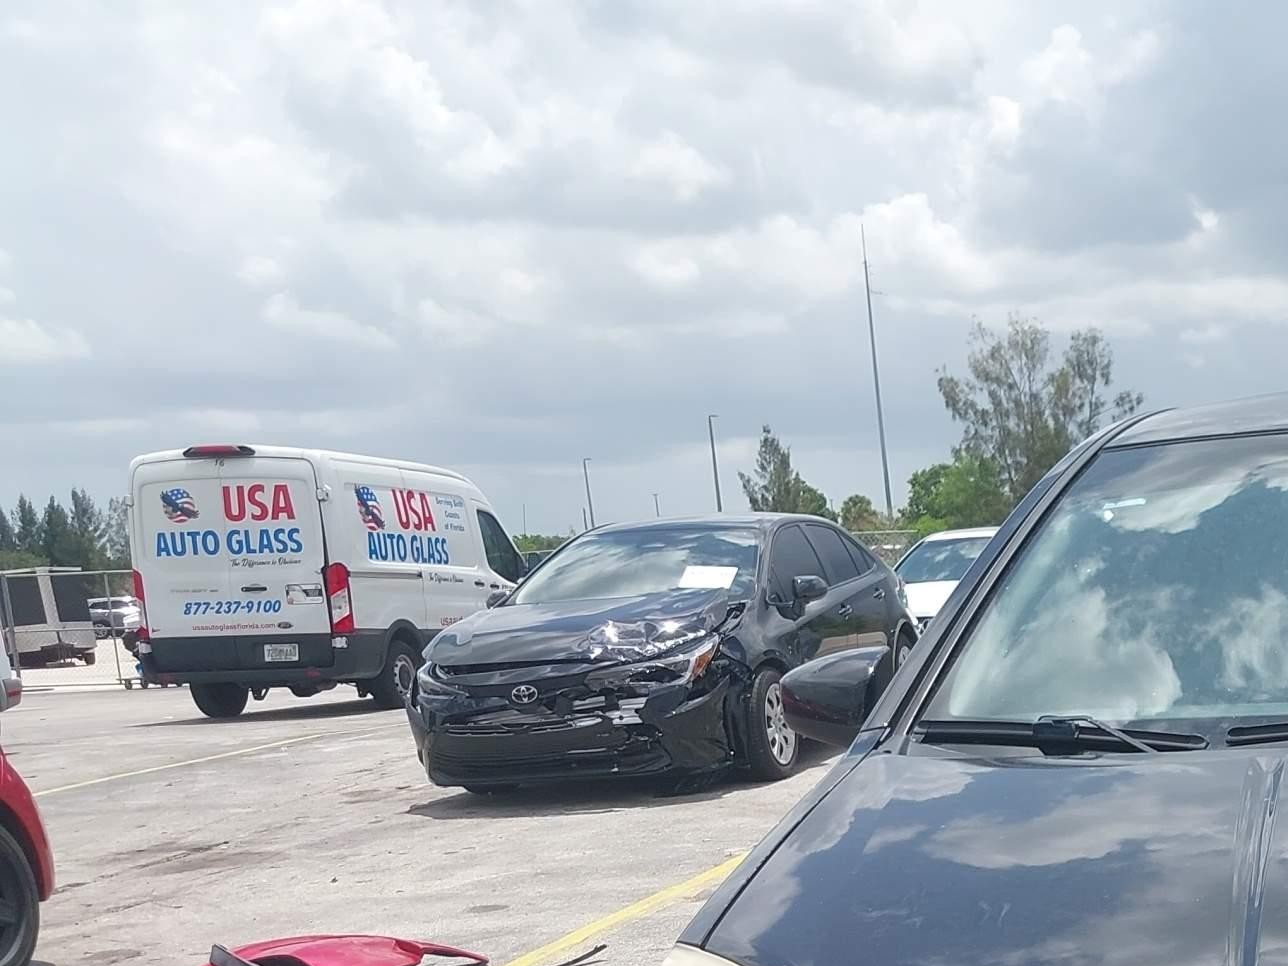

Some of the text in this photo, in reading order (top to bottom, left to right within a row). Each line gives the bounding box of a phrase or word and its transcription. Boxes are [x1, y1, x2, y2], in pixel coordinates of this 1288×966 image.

[222, 484, 296, 522] USA
[391, 489, 436, 531] USA
[156, 528, 303, 557] AUTO GLASS
[368, 532, 450, 565] AUTO GLASS
[184, 600, 282, 615] 877-237-9100
